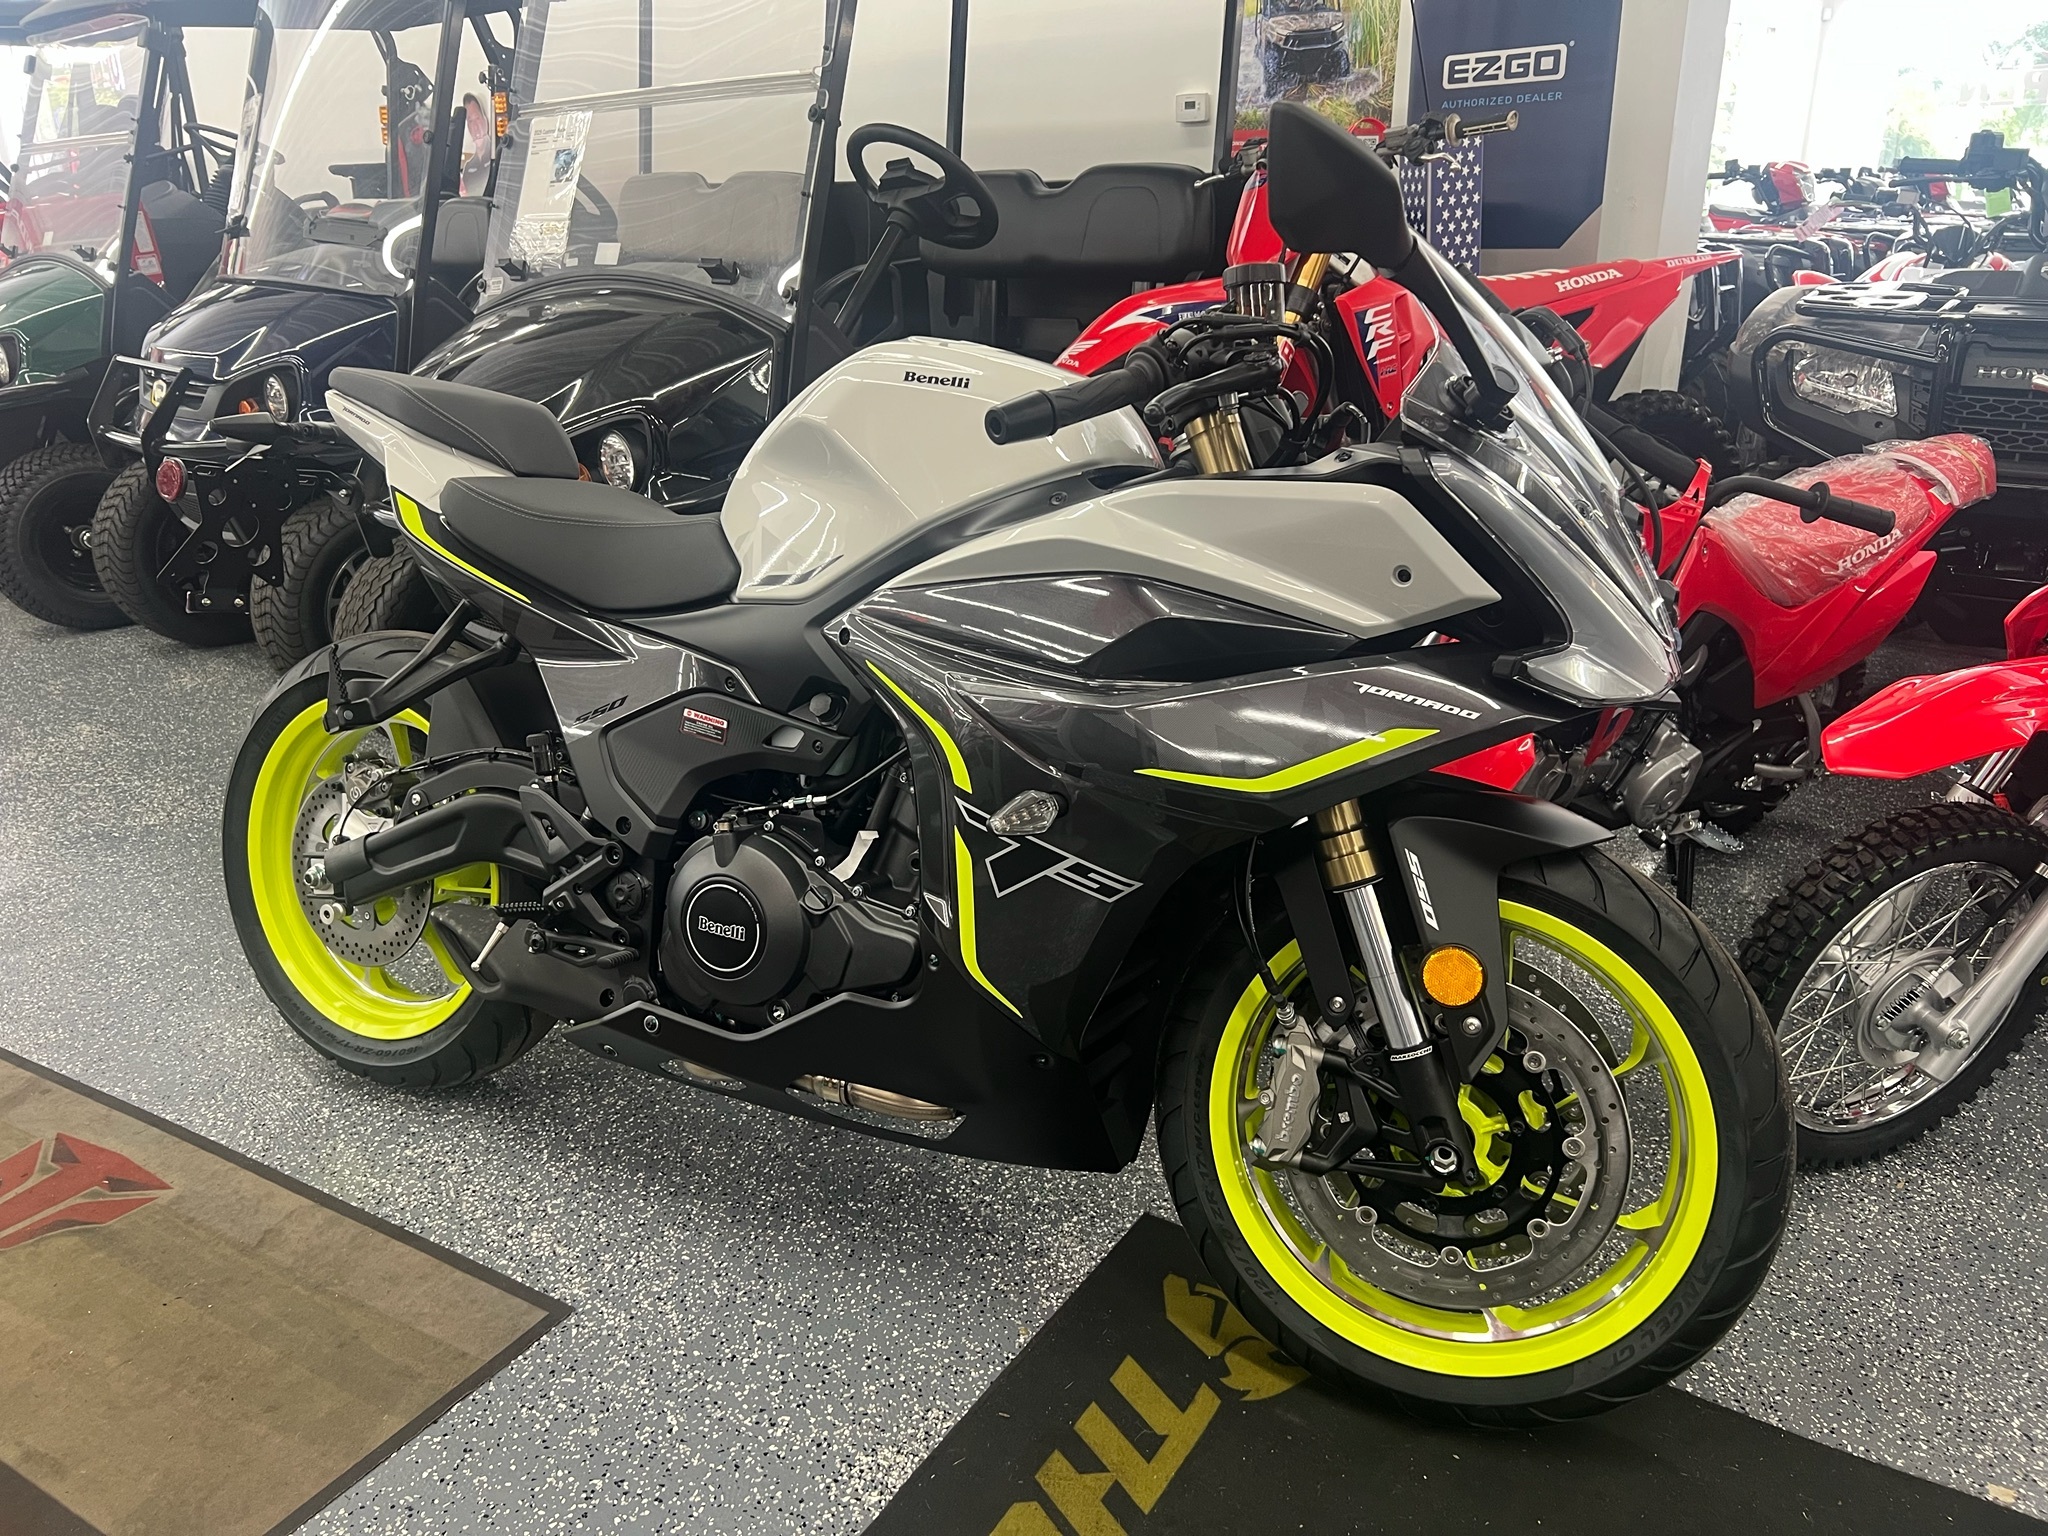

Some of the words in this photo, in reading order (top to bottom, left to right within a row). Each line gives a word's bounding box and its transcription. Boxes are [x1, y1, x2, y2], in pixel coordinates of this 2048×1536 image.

[1446, 47, 1563, 86] EZGO
[1441, 95, 1513, 110] AUTHORIZED
[1516, 91, 1563, 104] DEALER
[1554, 268, 1624, 293] HONDA
[1364, 303, 1396, 361] CRF
[903, 371, 970, 389] Benelli
[1837, 528, 1904, 573] HONDA
[573, 694, 629, 727] 550
[1353, 680, 1482, 720] TORNADO
[692, 711, 726, 727] WARNING
[1404, 847, 1440, 931] 550
[698, 915, 746, 942] Benelli
[1275, 1073, 1304, 1142] brembo
